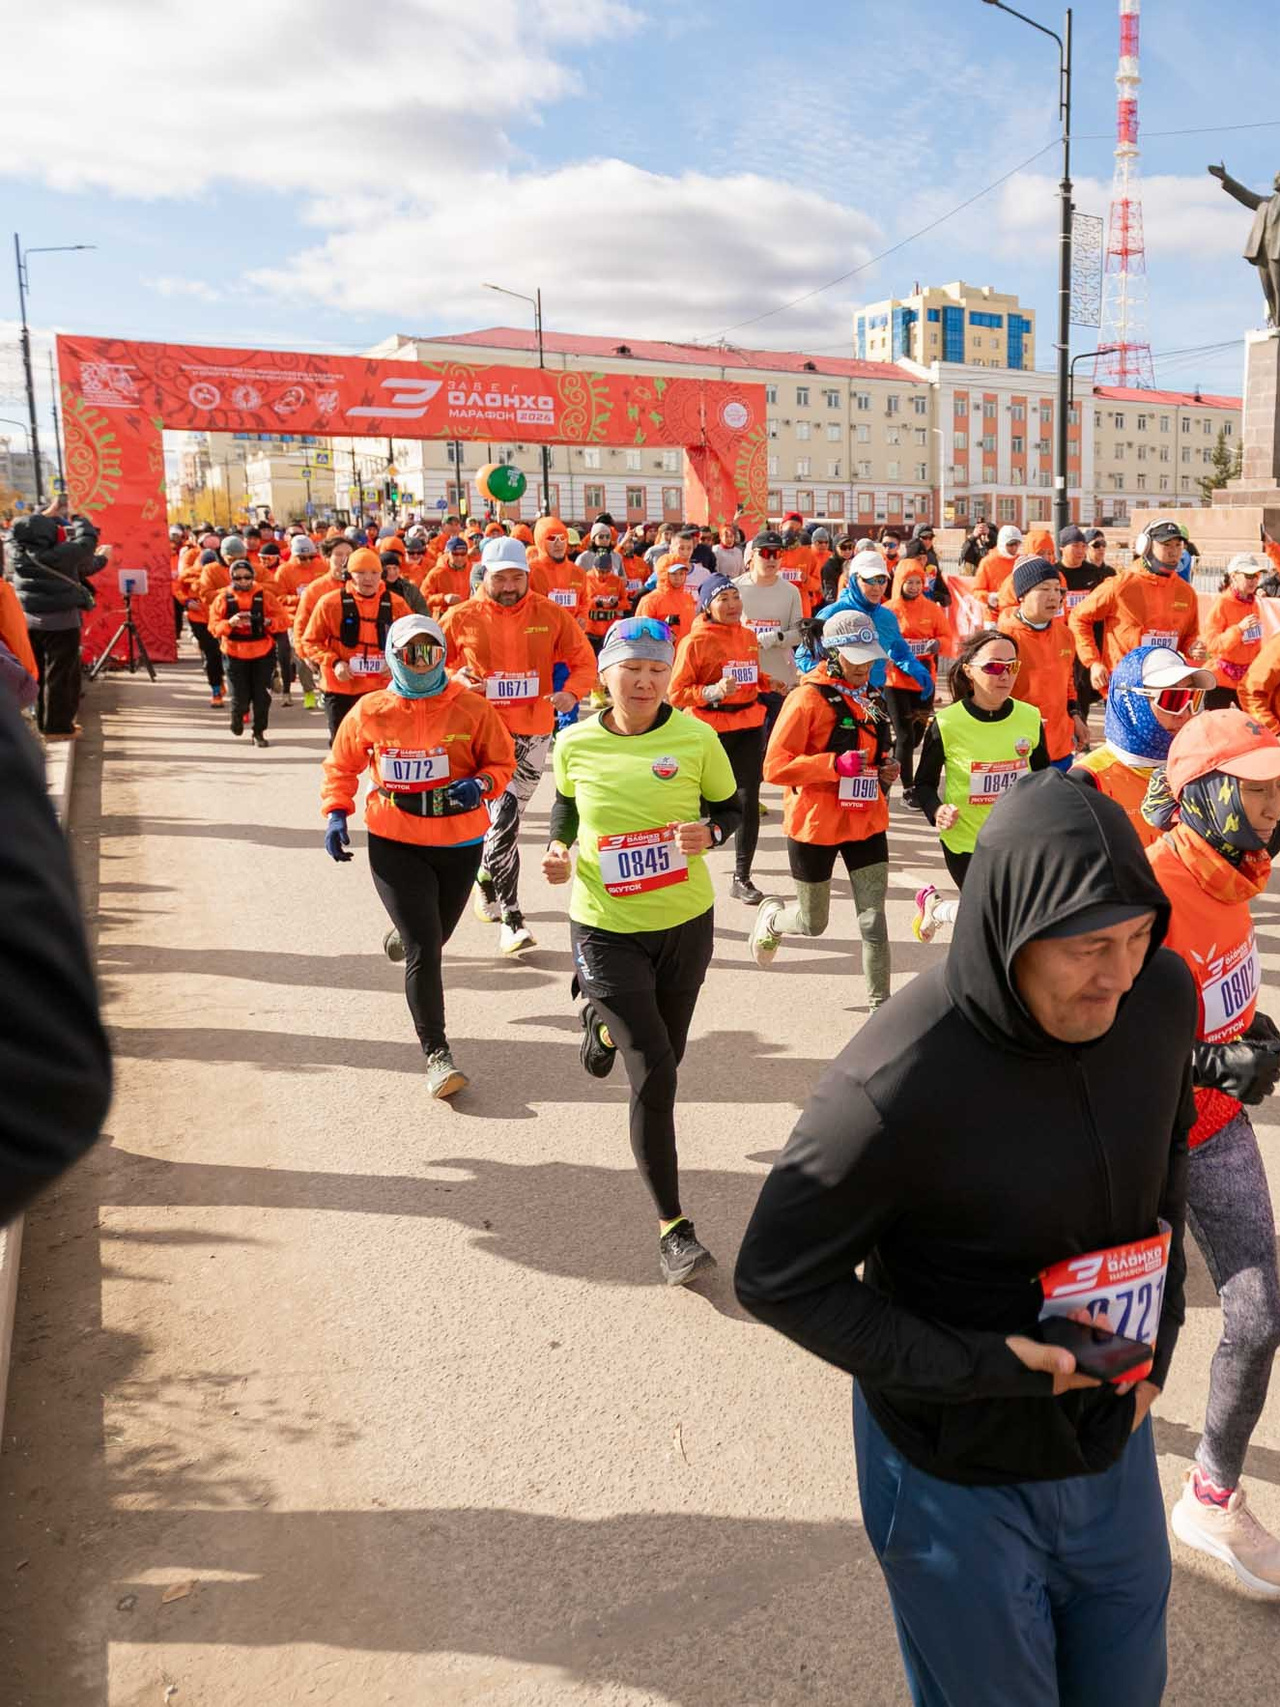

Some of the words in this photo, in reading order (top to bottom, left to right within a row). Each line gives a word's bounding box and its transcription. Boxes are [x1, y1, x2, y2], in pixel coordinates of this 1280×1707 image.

[447, 390, 555, 410] ОЛОНХО
[448, 408, 515, 421] МАРАФОН
[498, 680, 528, 697] 0671
[394, 759, 434, 780] 0772
[618, 845, 670, 879] 0845
[1221, 957, 1256, 1018] 0802
[1107, 1246, 1162, 1273] ОЛОНХО
